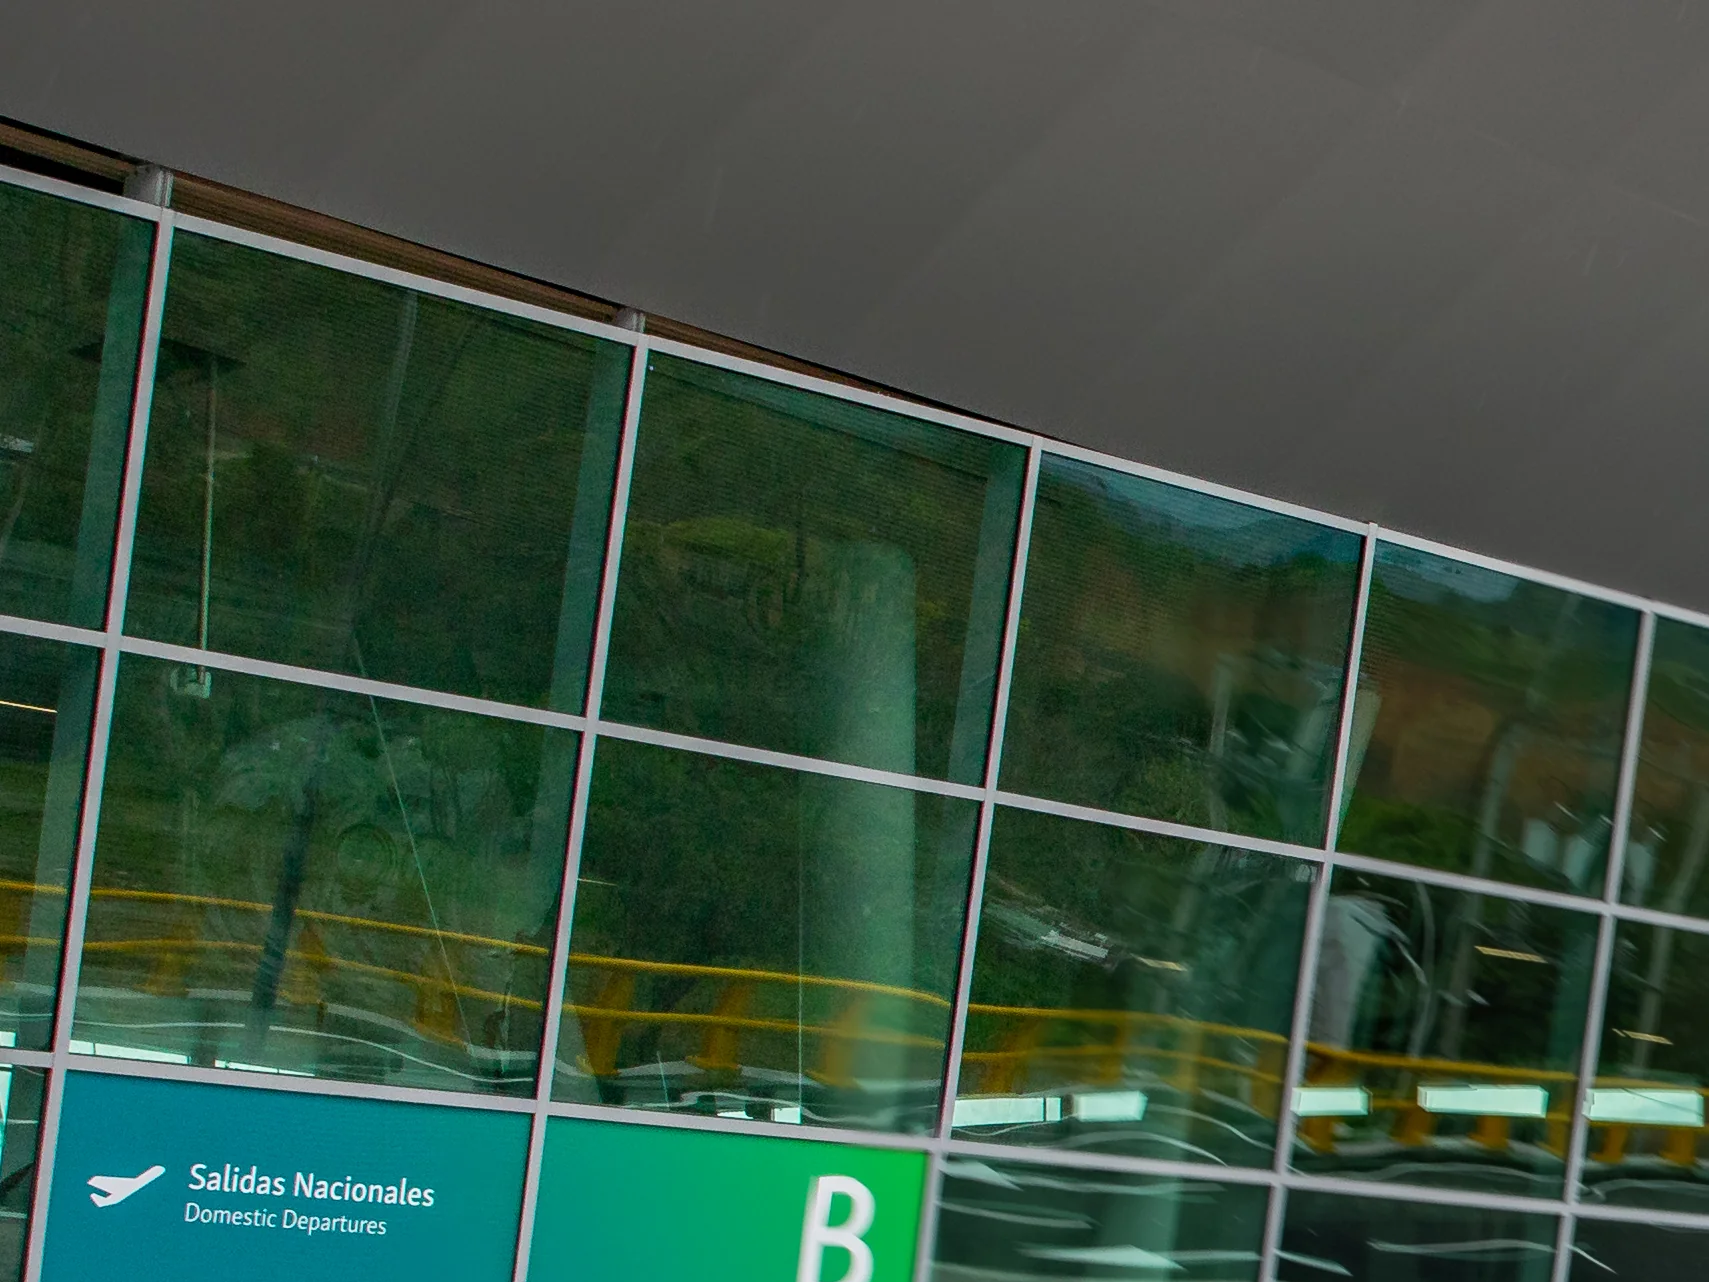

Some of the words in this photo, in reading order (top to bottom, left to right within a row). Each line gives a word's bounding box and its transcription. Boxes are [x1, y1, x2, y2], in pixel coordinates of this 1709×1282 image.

[188, 1163, 286, 1196] Salidas
[293, 1171, 435, 1207] Nacionales
[184, 1202, 277, 1228] Domestic
[282, 1209, 387, 1236] Departures
